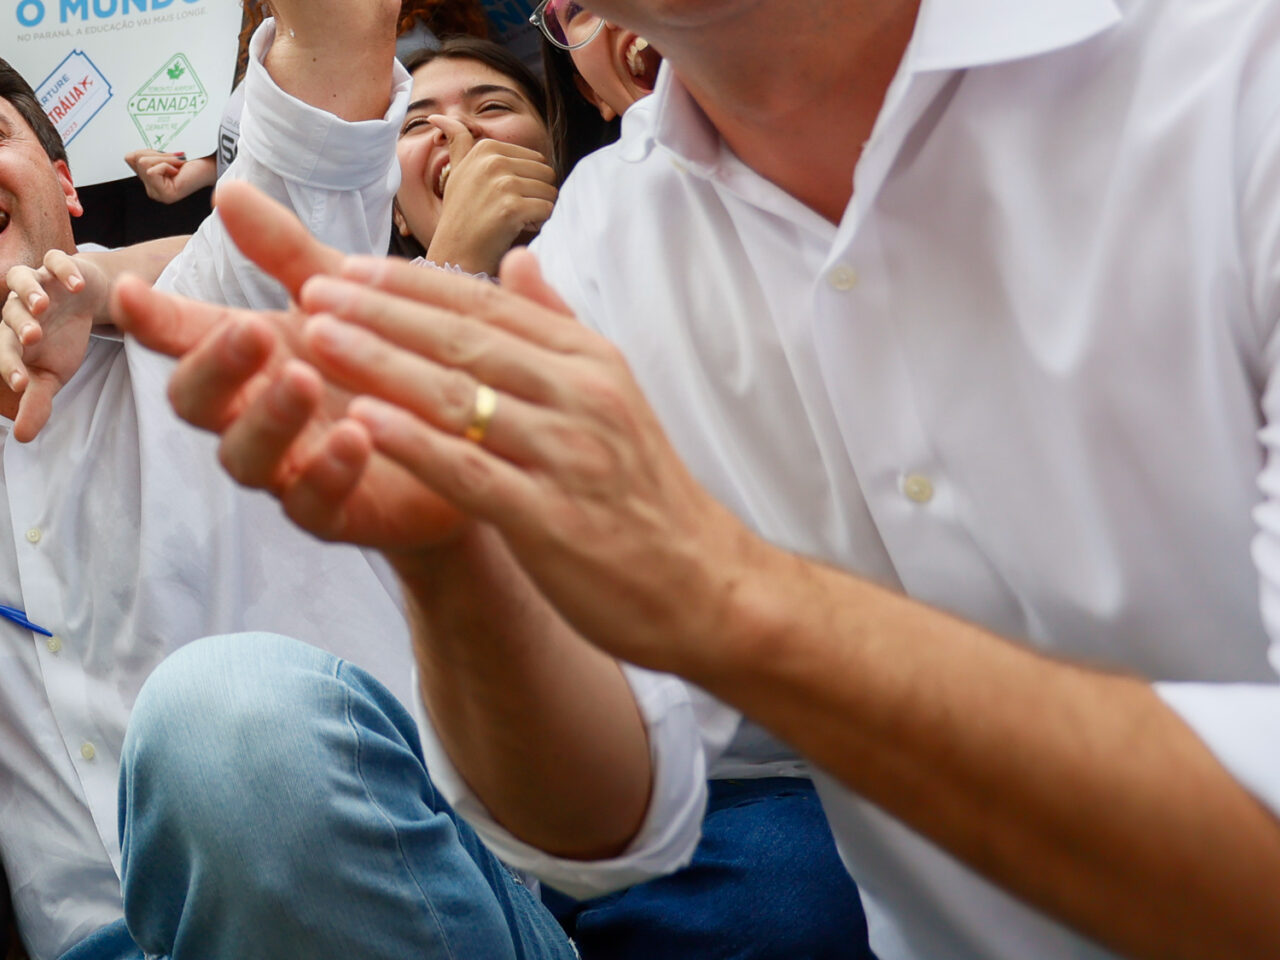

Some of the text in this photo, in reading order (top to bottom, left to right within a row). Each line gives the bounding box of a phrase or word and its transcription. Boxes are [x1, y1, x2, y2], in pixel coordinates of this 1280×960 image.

[17, 34, 32, 42] NO
[76, 28, 84, 36] A
[85, 19, 135, 36] EDUCAÇÃO
[137, 17, 152, 27] VAI
[153, 14, 174, 24] MAIS
[40, 73, 70, 107] RTURE
[50, 86, 85, 125] TRÁLIA
[137, 95, 198, 113] CANADA
